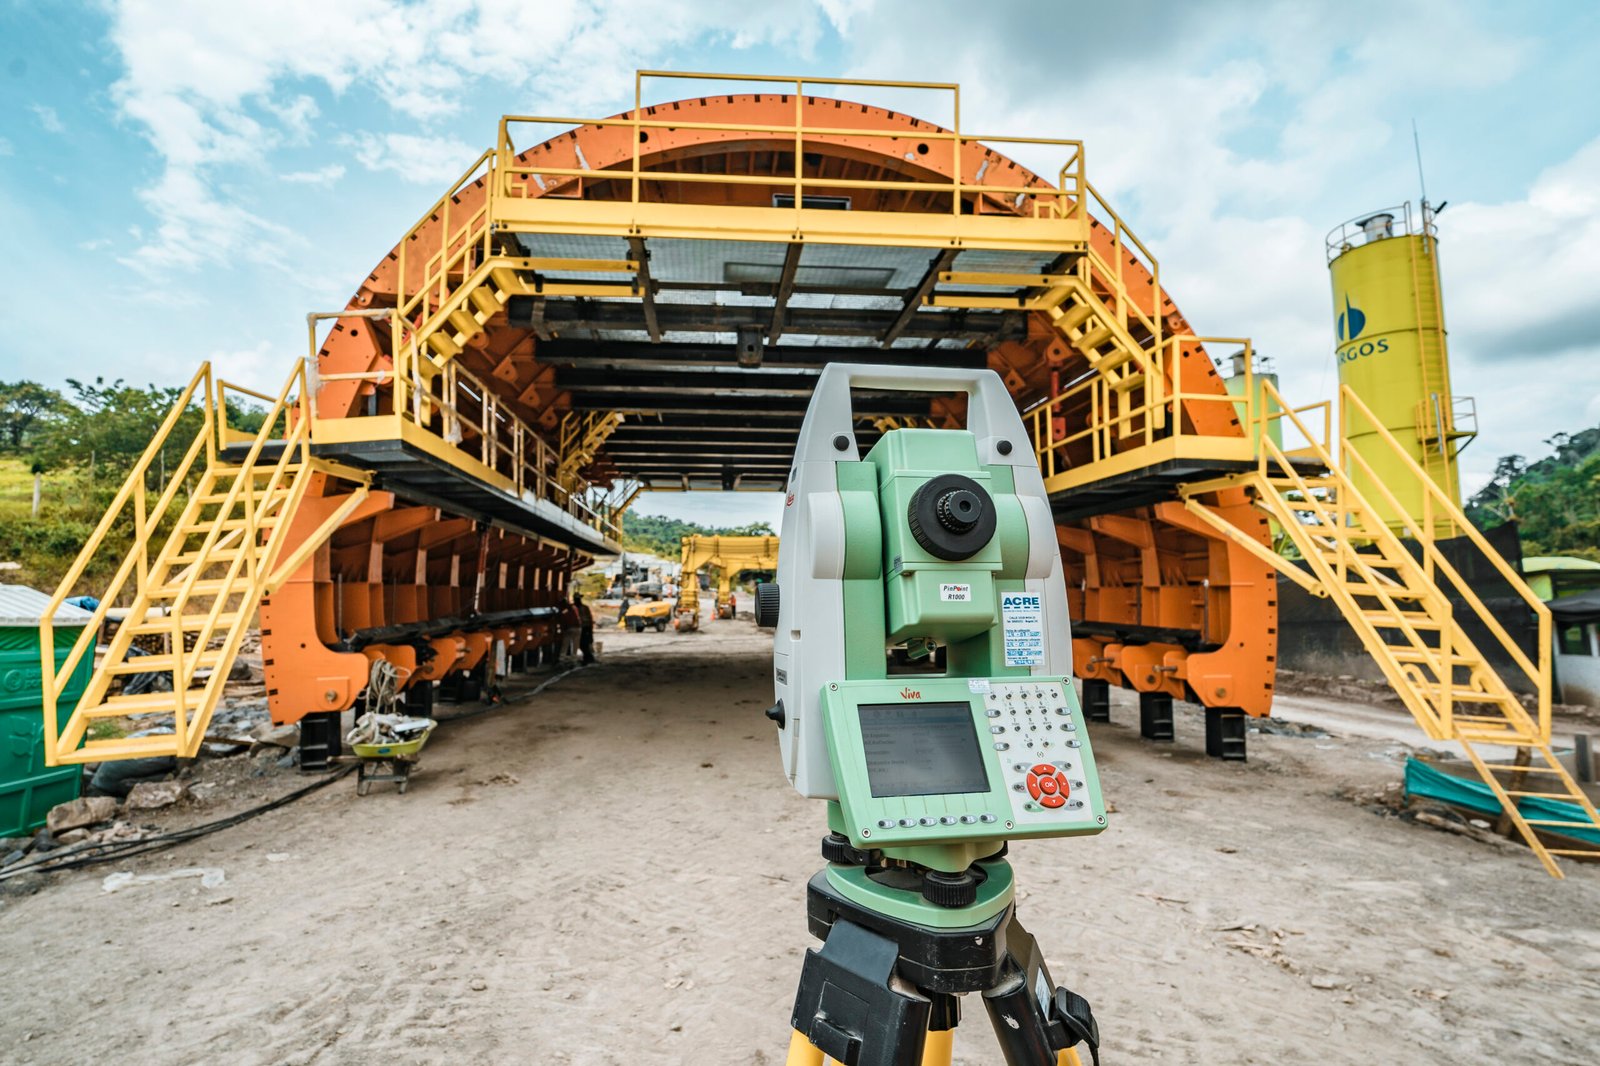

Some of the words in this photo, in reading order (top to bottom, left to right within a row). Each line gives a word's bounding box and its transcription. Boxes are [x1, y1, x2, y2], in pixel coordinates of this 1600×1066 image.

[1337, 338, 1389, 364] RGOS
[1003, 596, 1040, 606] ACRE
[900, 687, 922, 699] Viva
